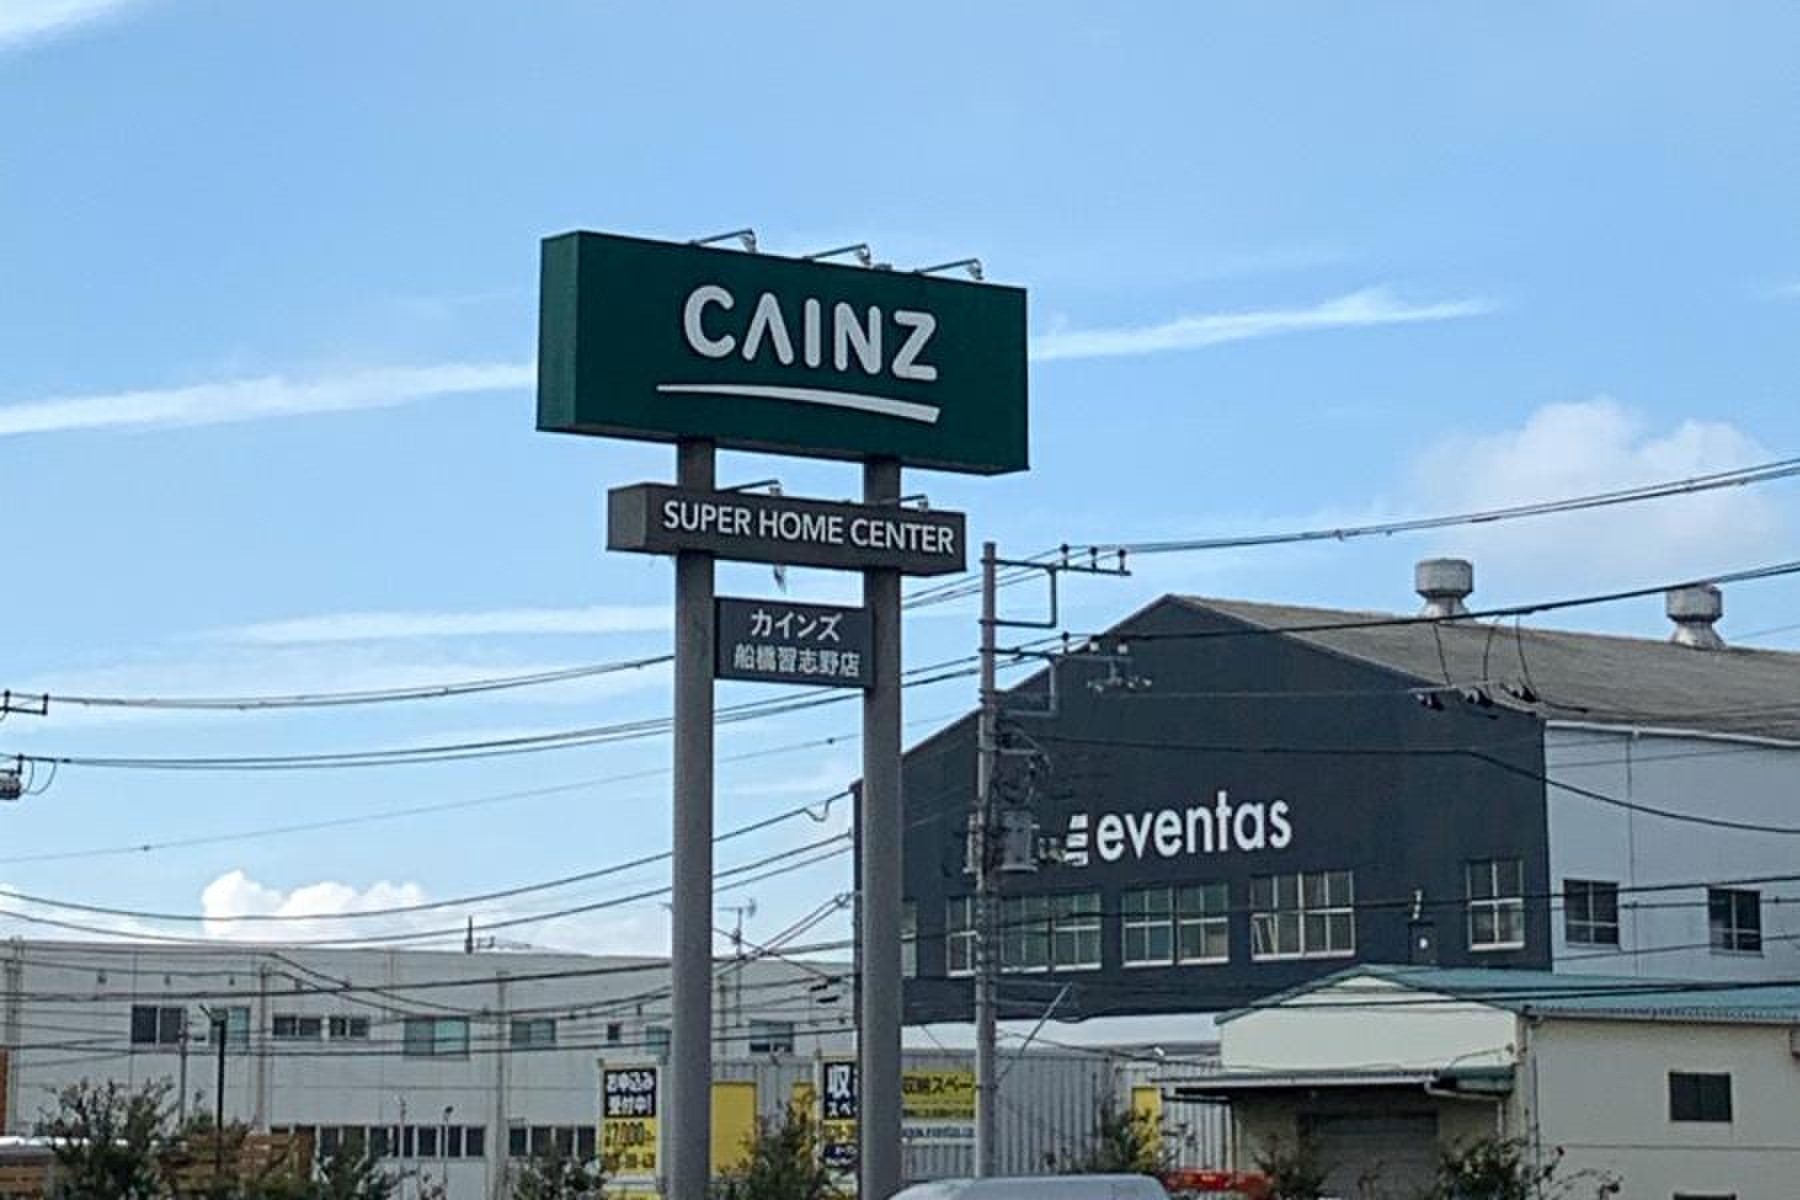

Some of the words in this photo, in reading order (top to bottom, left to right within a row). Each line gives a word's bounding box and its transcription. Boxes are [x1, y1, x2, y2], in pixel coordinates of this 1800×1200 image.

[684, 285, 938, 382] CAINZ
[664, 501, 751, 536] SUPER
[758, 509, 844, 543] HOME
[850, 519, 954, 553] CENTER
[751, 608, 843, 642] カインズ
[734, 643, 860, 677] 船橋習志野店
[1096, 791, 1292, 861] eventas
